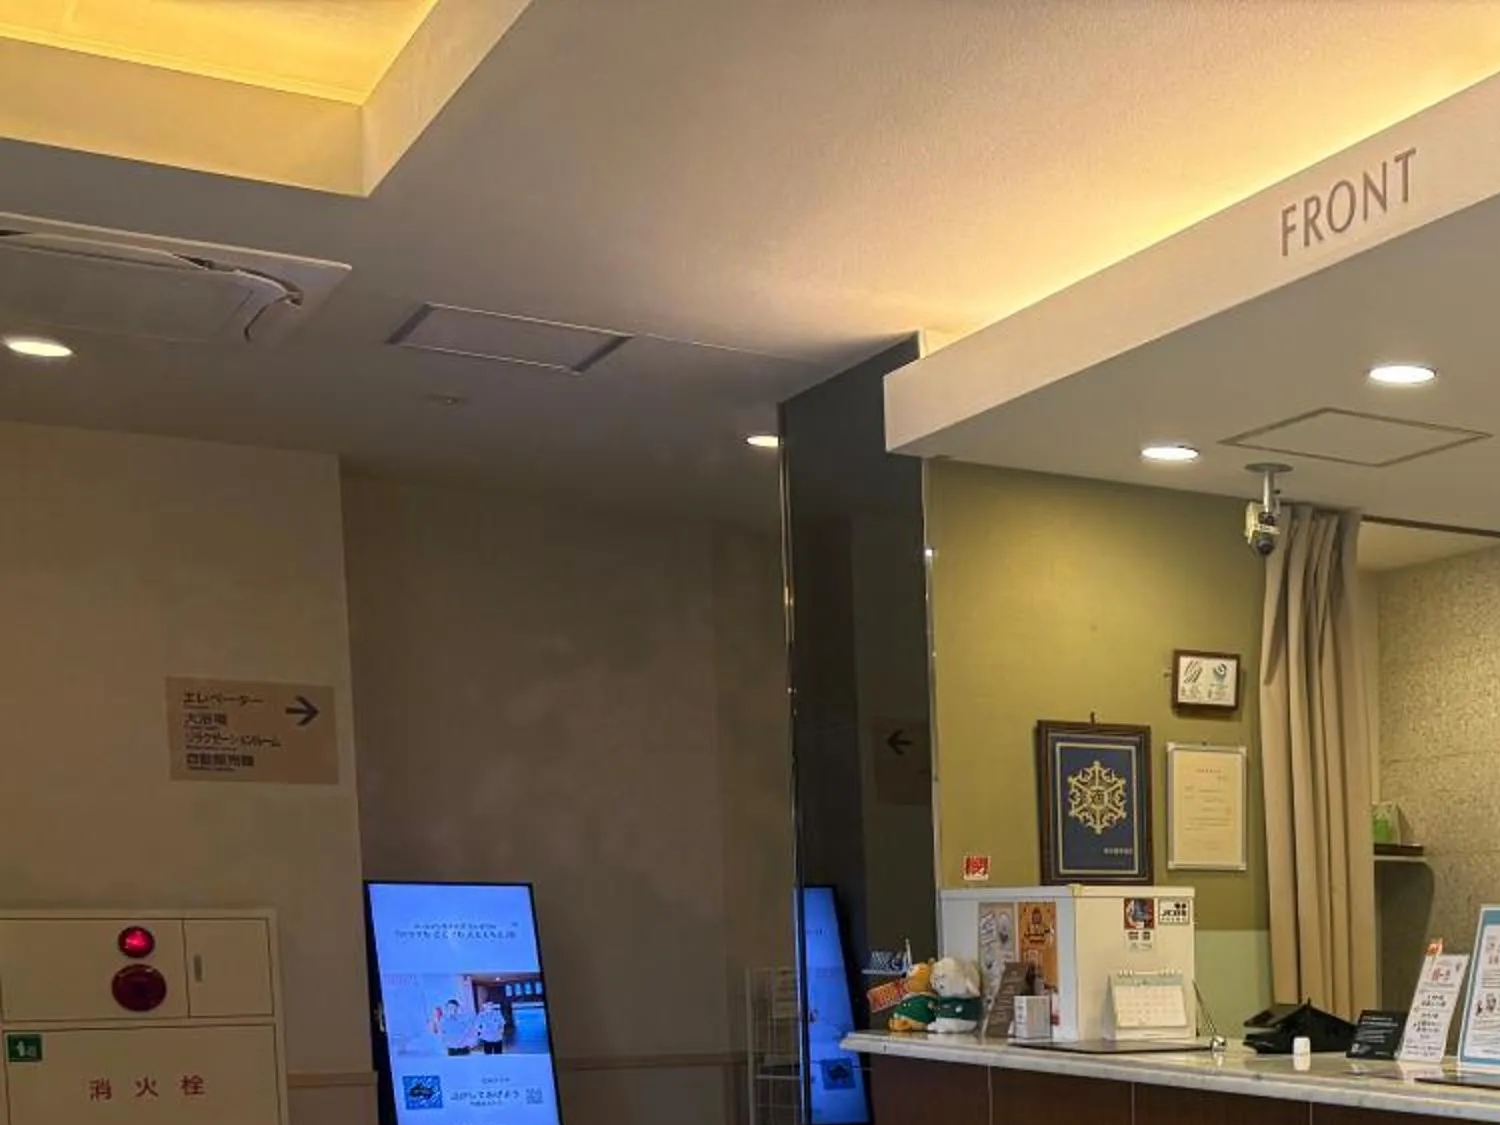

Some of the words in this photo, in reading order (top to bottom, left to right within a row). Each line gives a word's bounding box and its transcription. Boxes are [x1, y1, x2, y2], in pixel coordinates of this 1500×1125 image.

[1281, 147, 1417, 257] FRONT
[89, 1075, 206, 1101] 消火栓
